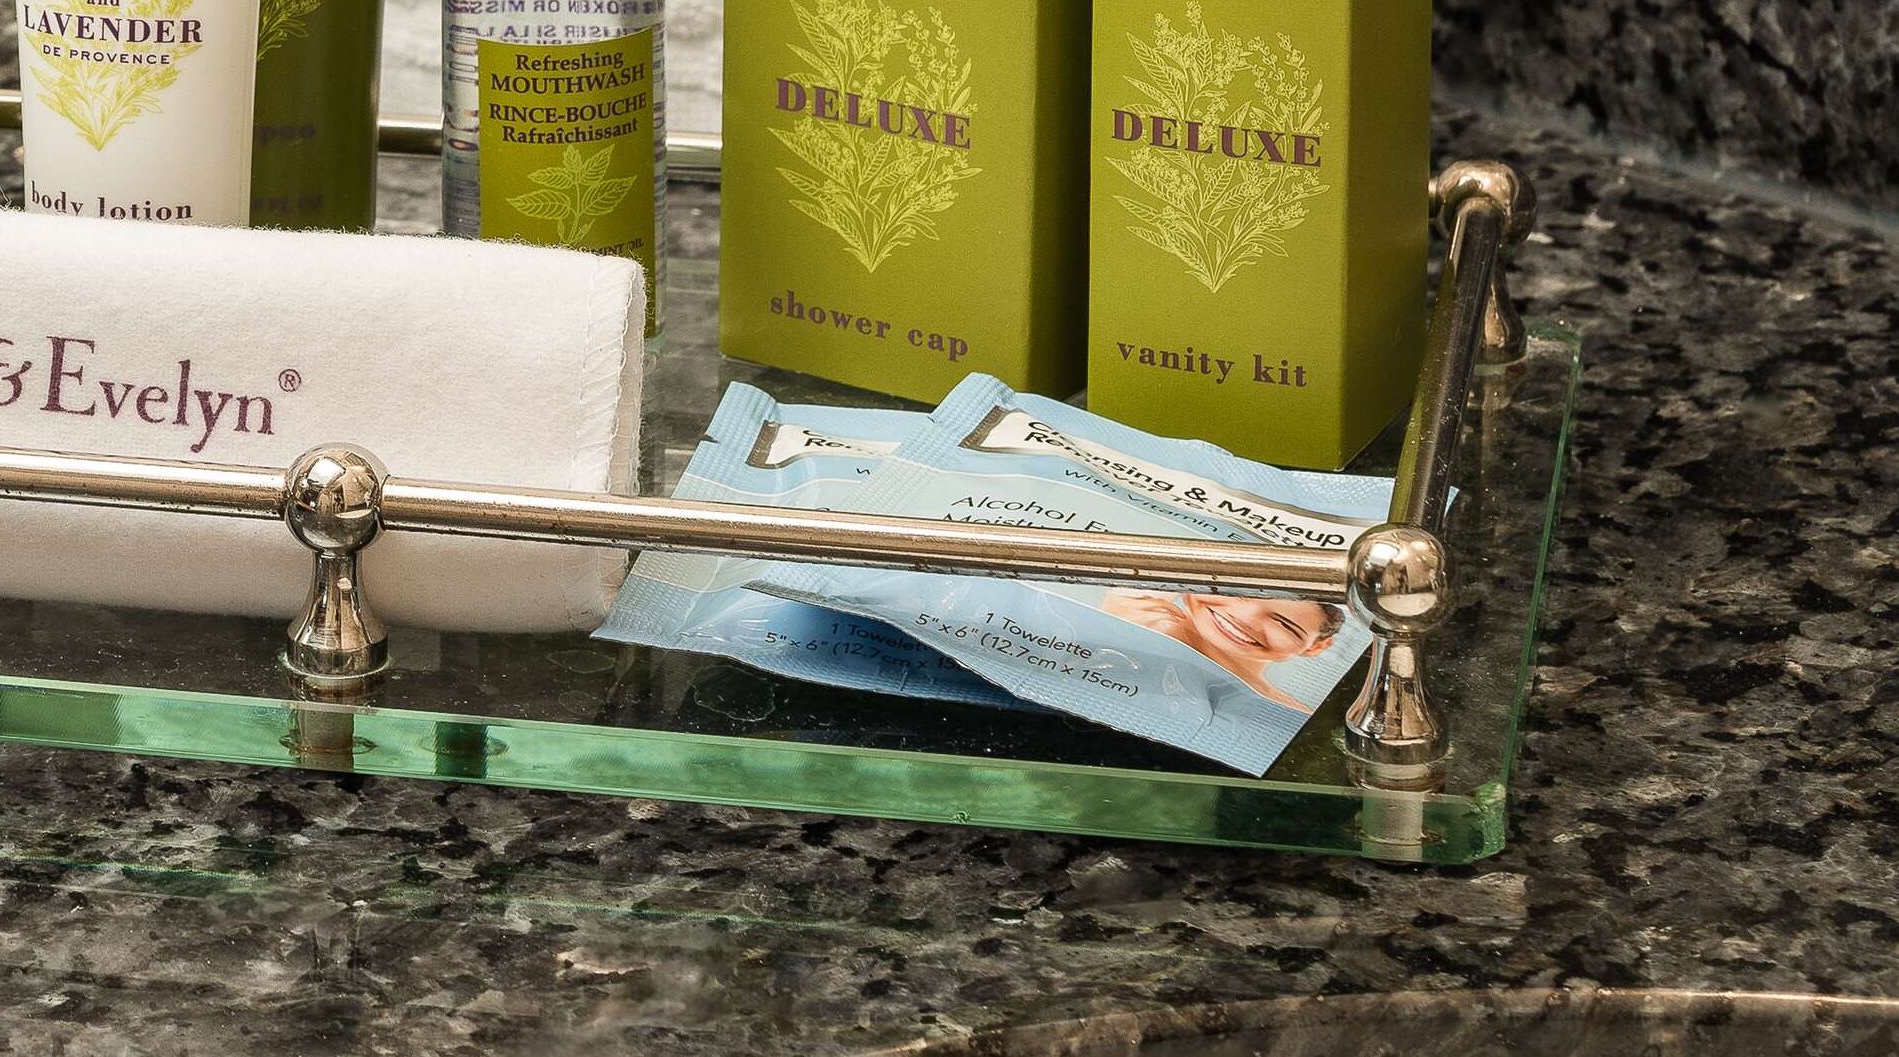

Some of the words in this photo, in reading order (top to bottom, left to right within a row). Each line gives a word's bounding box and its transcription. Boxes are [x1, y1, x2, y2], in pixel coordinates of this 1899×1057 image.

[22, 3, 203, 44] LAVENDER
[43, 45, 63, 57] DE
[69, 49, 171, 65] PROVENCE
[515, 50, 624, 72] Refreshing
[490, 62, 645, 95] MOUTHWASH
[489, 92, 647, 124] RINCE-BOUCHE
[775, 77, 973, 151] DELUXE
[502, 118, 638, 145] Rafraîchissant
[1111, 108, 1323, 169] DELUXE
[30, 180, 84, 217] body
[97, 196, 193, 221] lotion
[770, 290, 891, 340] shower
[907, 323, 970, 360] cap
[1116, 341, 1235, 389] vanity
[1253, 354, 1308, 388] kit
[951, 496, 1077, 523] Alcohol
[1184, 485, 1209, 504] &
[985, 611, 994, 625] 1
[1000, 615, 1093, 660] Towelette
[980, 630, 1057, 672] (12.7cm
[1061, 665, 1072, 675] x
[1081, 667, 1140, 698] 15cm)
